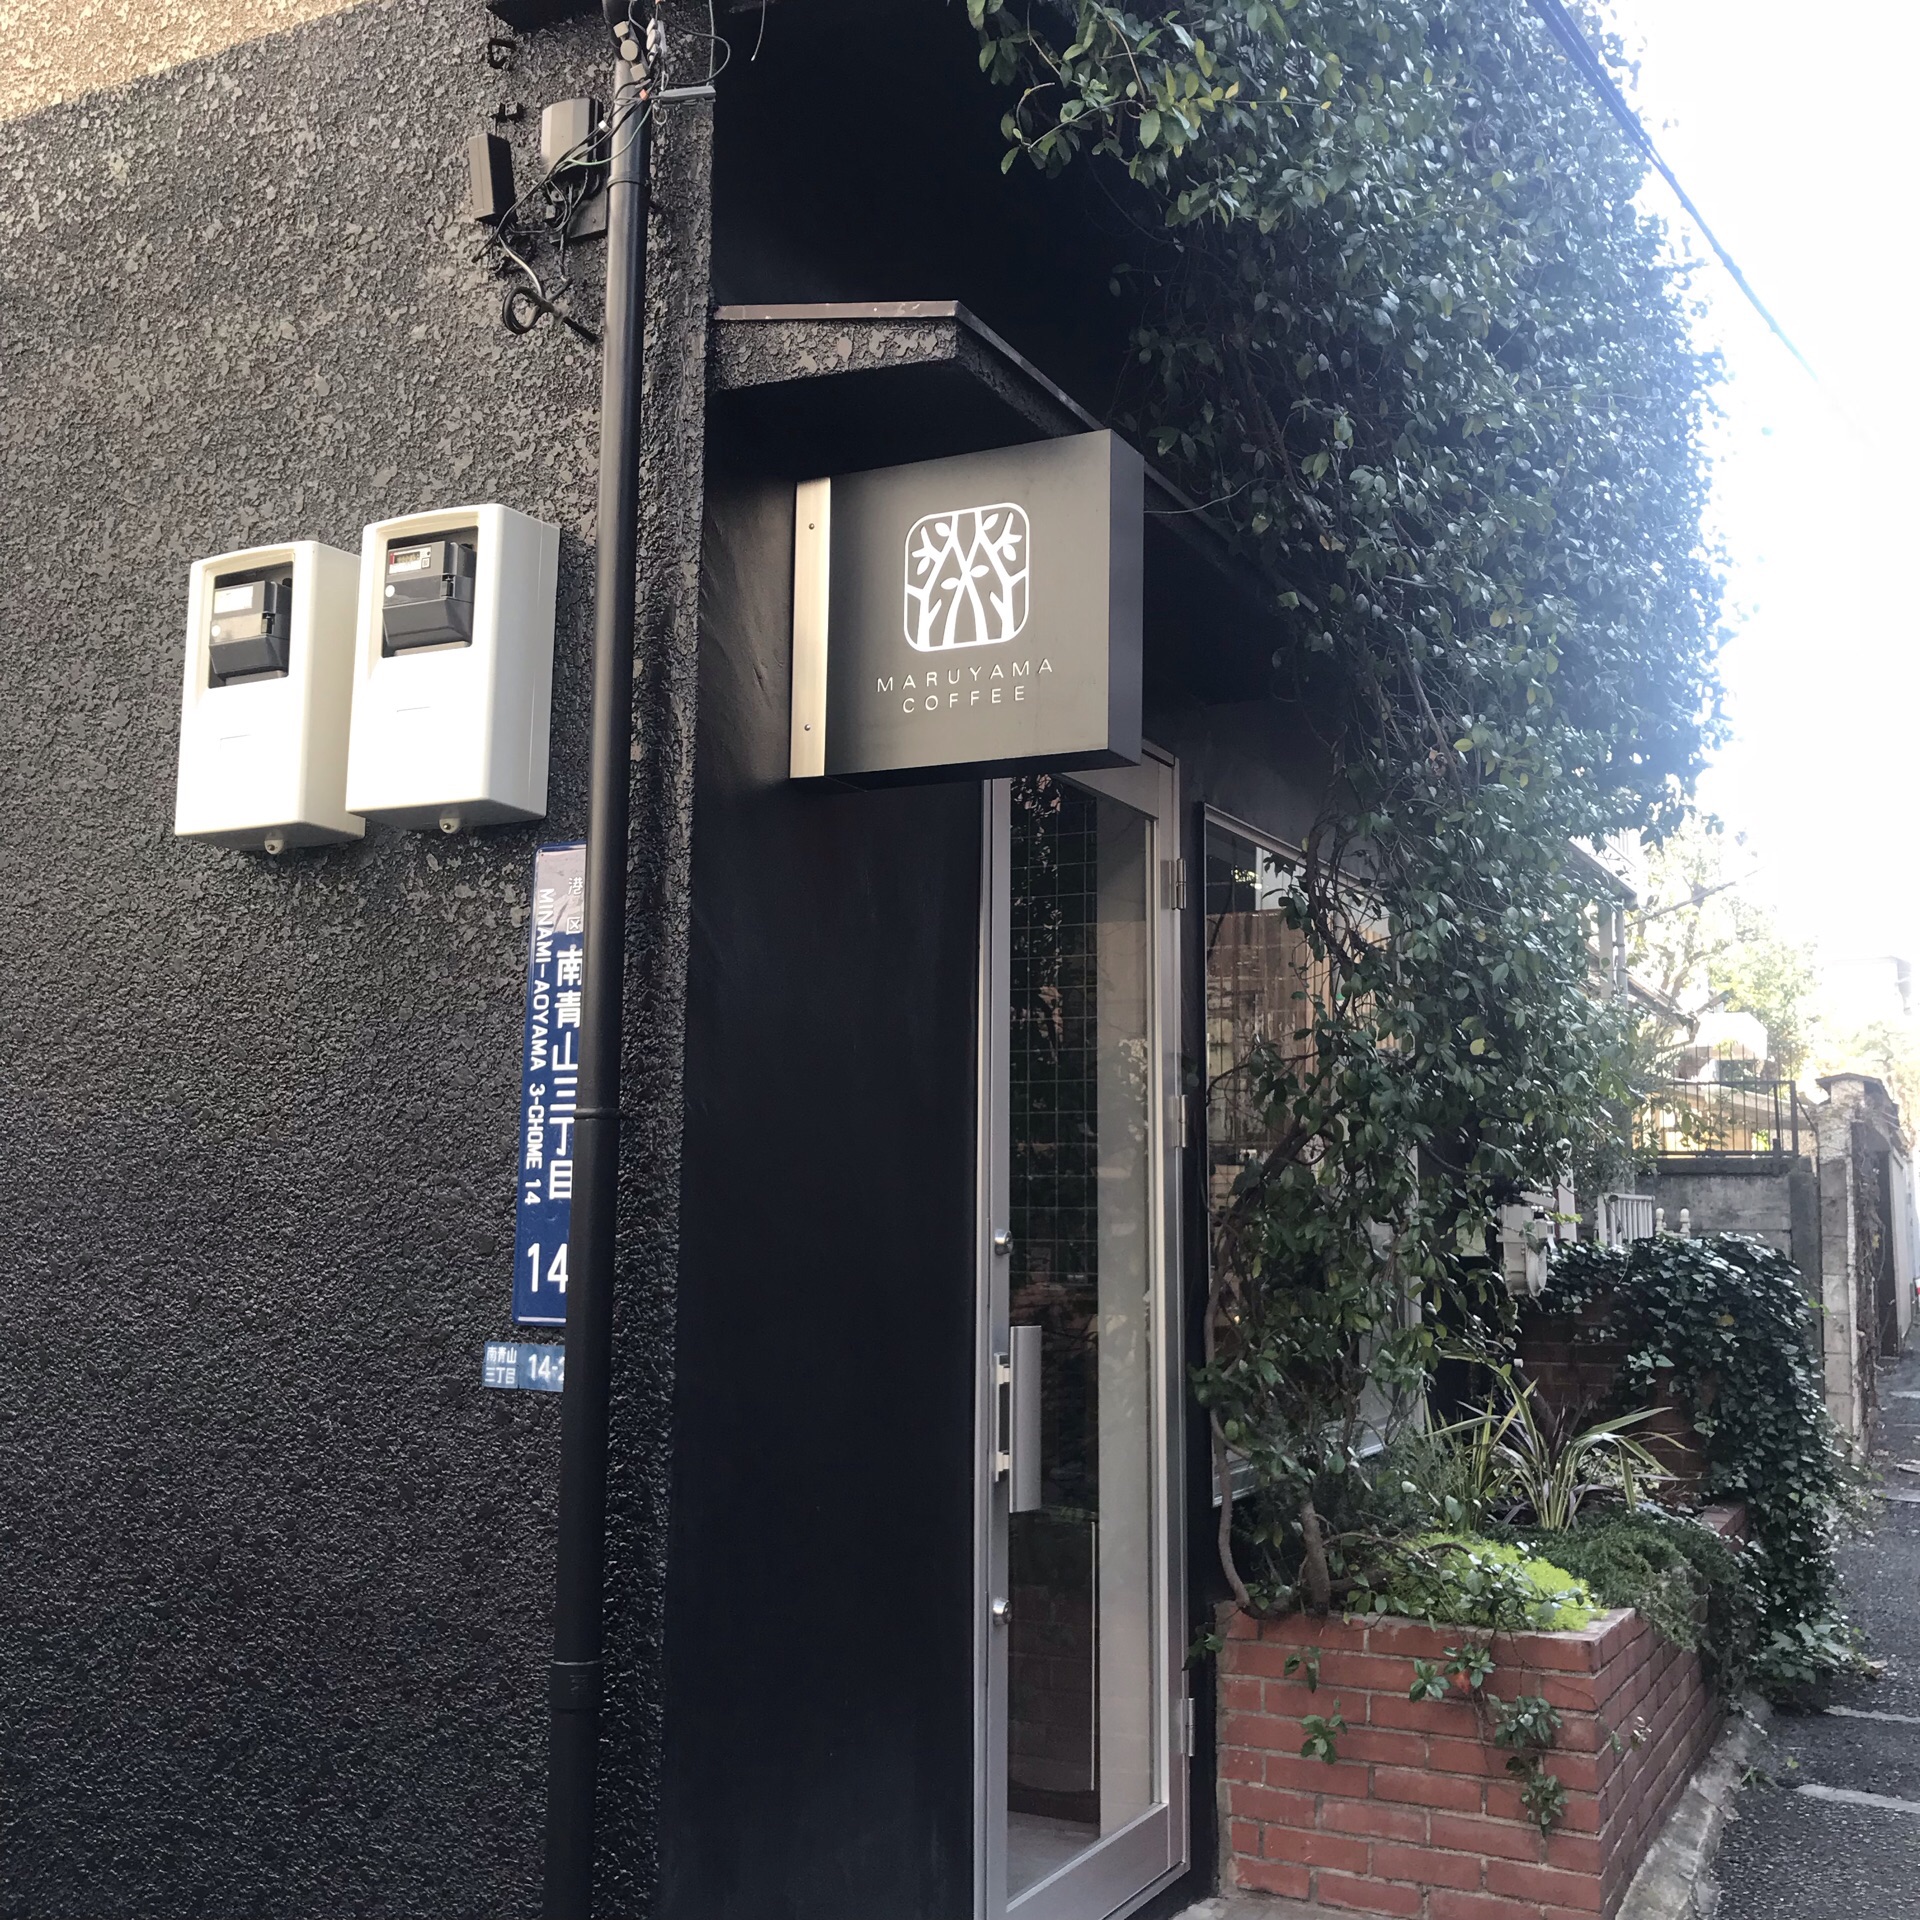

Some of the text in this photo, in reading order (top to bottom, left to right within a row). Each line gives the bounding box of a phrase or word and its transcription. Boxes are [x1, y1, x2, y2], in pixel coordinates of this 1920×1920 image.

[877, 658, 1053, 692] MARUYAMA
[902, 686, 1025, 713] COFFEE
[566, 877, 584, 935] 港区
[524, 888, 555, 1205] MINAMI-AOYAMA 3-CHOME 14
[549, 944, 583, 1199] 南青山三丁目
[527, 1243, 568, 1293] 14
[484, 1367, 516, 1384] 三丁目
[486, 1345, 517, 1364] 南青山
